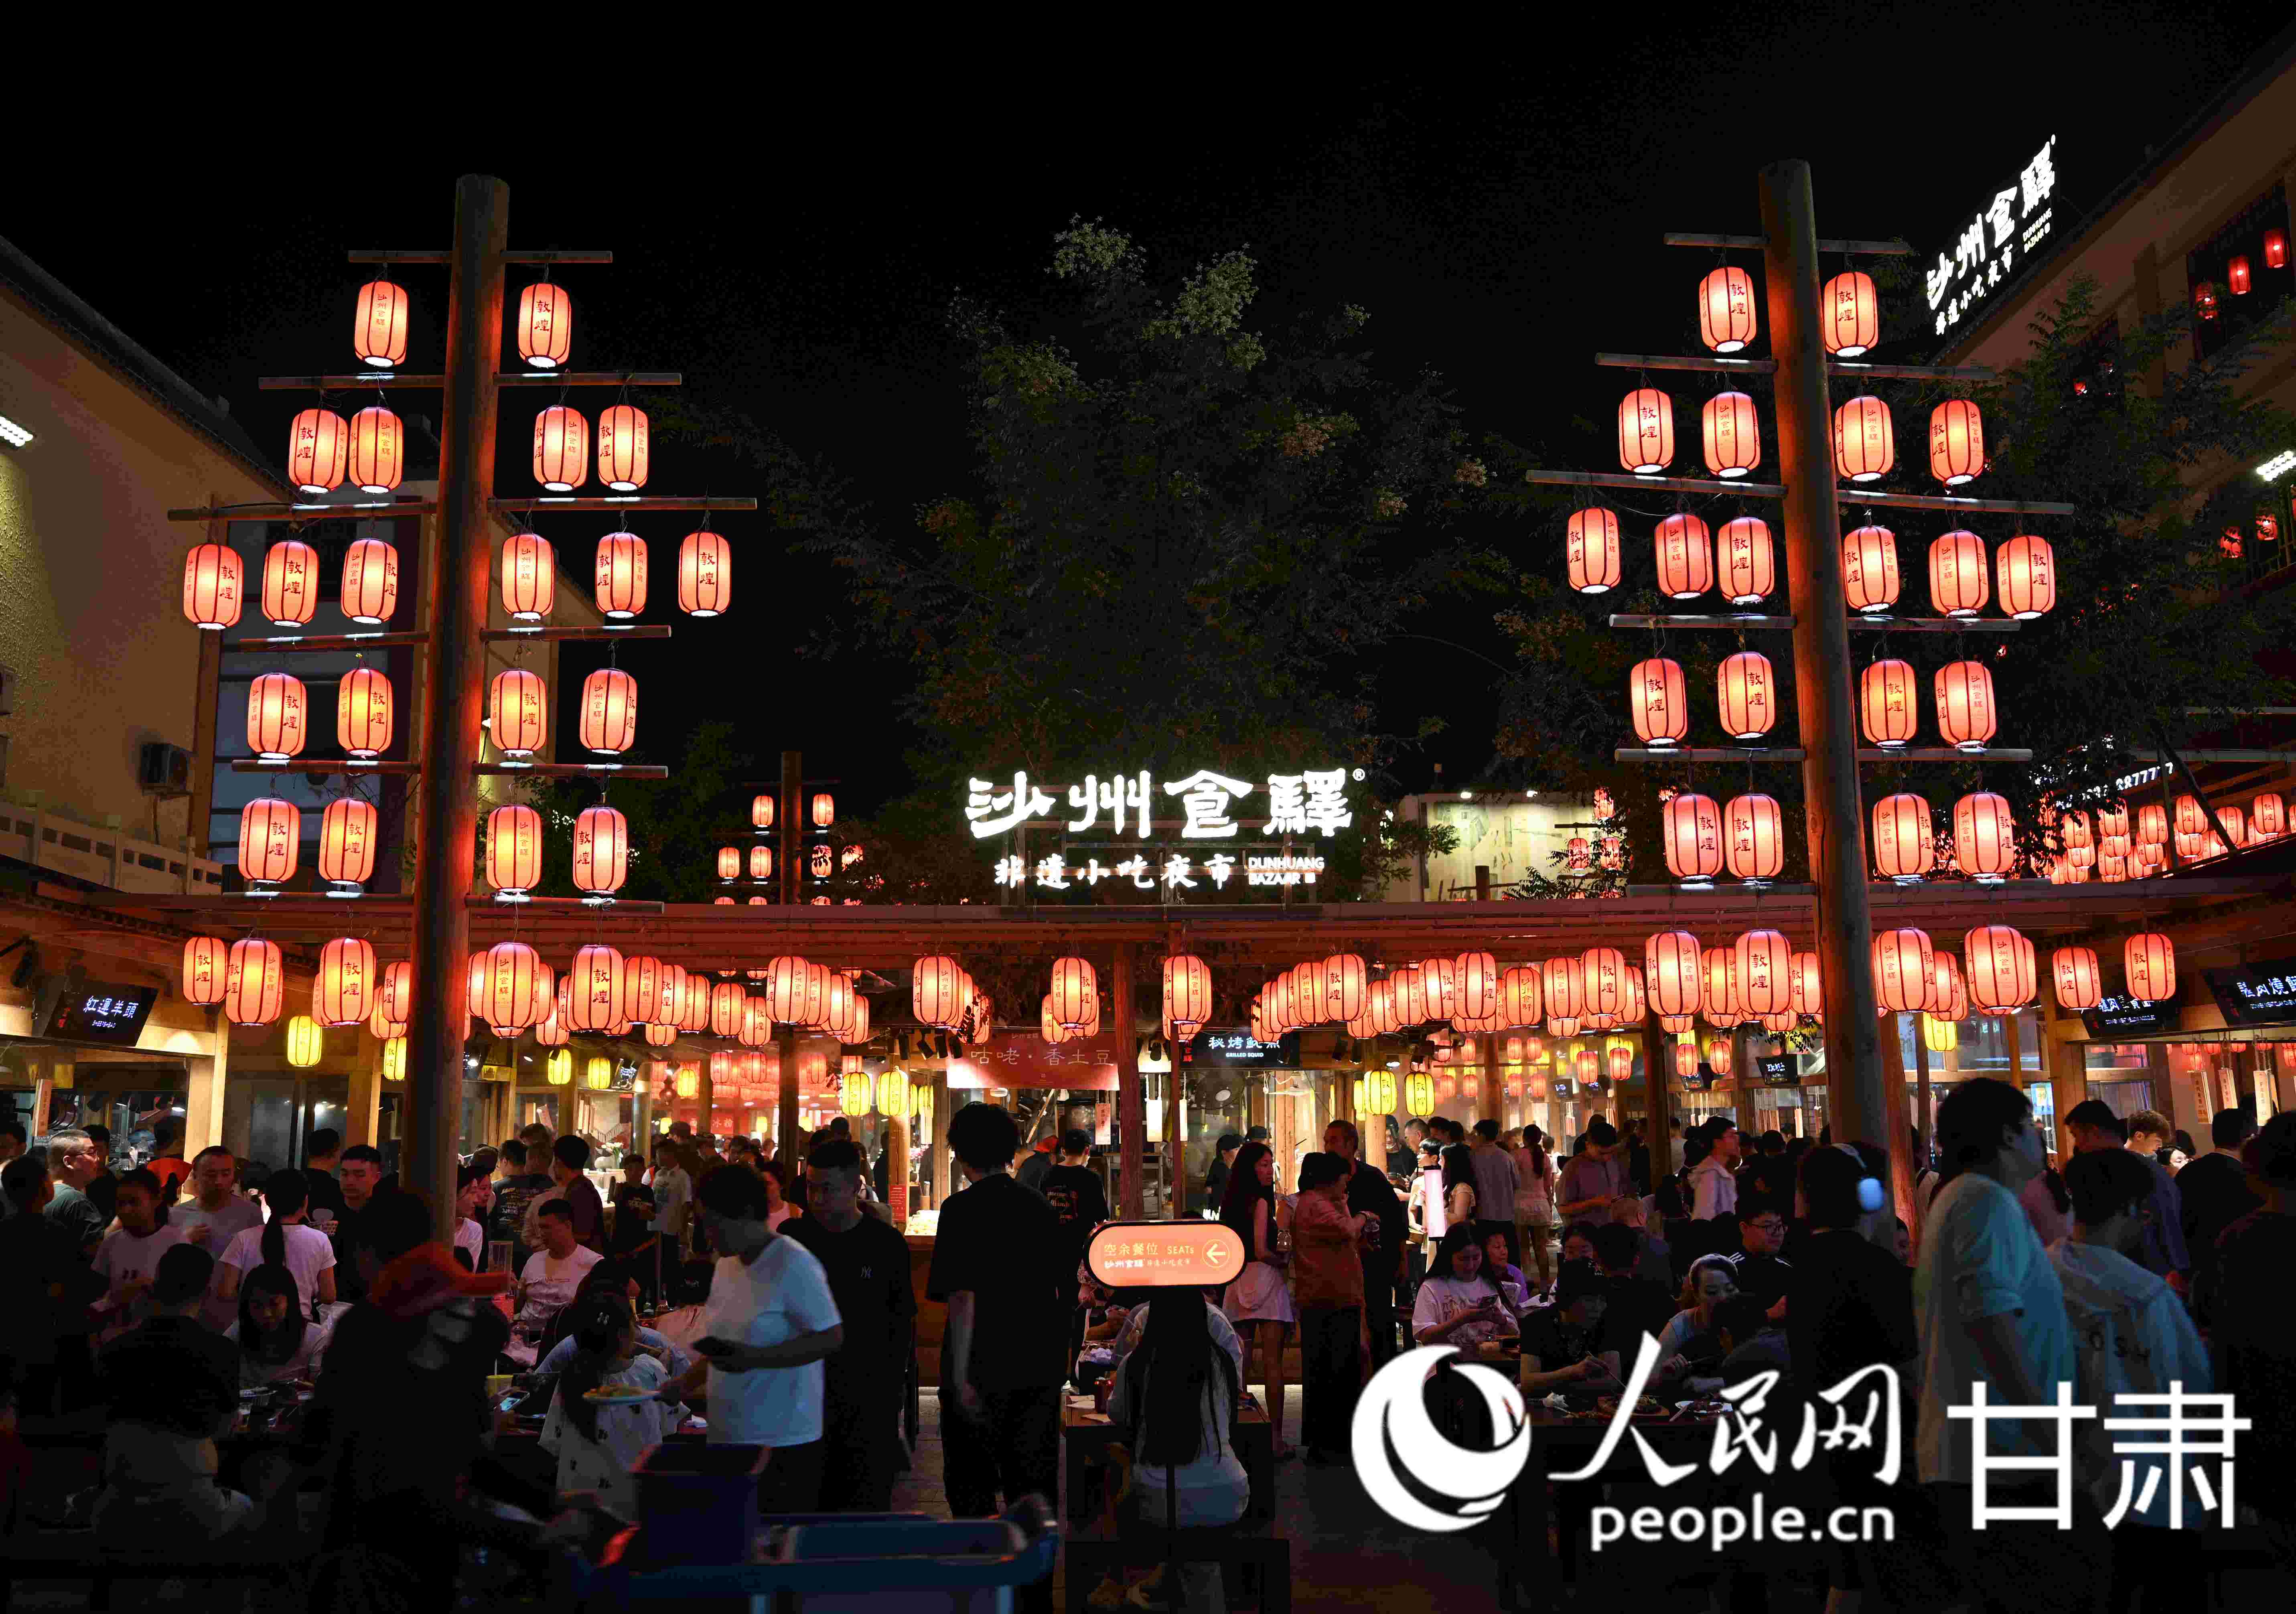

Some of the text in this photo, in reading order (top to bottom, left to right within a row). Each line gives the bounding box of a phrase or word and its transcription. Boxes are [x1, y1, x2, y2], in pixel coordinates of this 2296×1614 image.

[1730, 283, 1745, 314] 敦煌
[1838, 291, 1854, 321] 敦煌
[535, 300, 550, 331] 敦煌
[1641, 407, 1657, 438] 敦煌
[298, 428, 314, 458] 敦煌
[600, 425, 611, 457] 敦煌
[1932, 423, 1945, 455] 敦煌
[1570, 530, 1581, 563] 敦煌
[1733, 538, 1749, 570] 敦煌
[219, 565, 235, 600] 敦煌
[284, 560, 302, 594] 敦煌
[385, 562, 396, 596] 敦煌
[598, 554, 610, 586] 敦煌
[699, 552, 715, 585] 敦煌
[1845, 551, 1860, 583] 敦煌
[2032, 554, 2047, 585] 敦煌
[1647, 679, 1664, 711] 敦煌
[1748, 673, 1764, 705] 敦煌
[1886, 683, 1903, 712] 敦煌
[283, 694, 299, 729] 敦煌
[371, 691, 385, 724] 敦煌
[523, 693, 537, 726] 敦煌
[965, 769, 1352, 839] 沙州食驛
[269, 822, 286, 856] 敦煌
[345, 823, 362, 854] 敦煌
[577, 831, 591, 865] 敦煌
[1699, 816, 1714, 850] 敦煌
[1735, 818, 1750, 851] 敦煌
[1248, 856, 1324, 870] DUNHUANG
[1249, 872, 1300, 885] BAZAAR
[196, 955, 211, 982] 敦煌
[227, 963, 240, 994] 敦煌
[344, 963, 360, 996] 敦煌
[1602, 965, 1614, 993] 敦煌
[1752, 954, 1767, 988] 敦煌
[2061, 965, 2074, 990] 敦煌
[2133, 953, 2147, 981] 敦煌
[384, 978, 393, 1003] 敦煌
[593, 969, 610, 1004] 敦煌
[1081, 976, 1090, 1004] 敦煌
[1330, 972, 1340, 1000] 敦煌
[1442, 975, 1453, 1000] 敦煌
[1485, 971, 1493, 998] 敦煌
